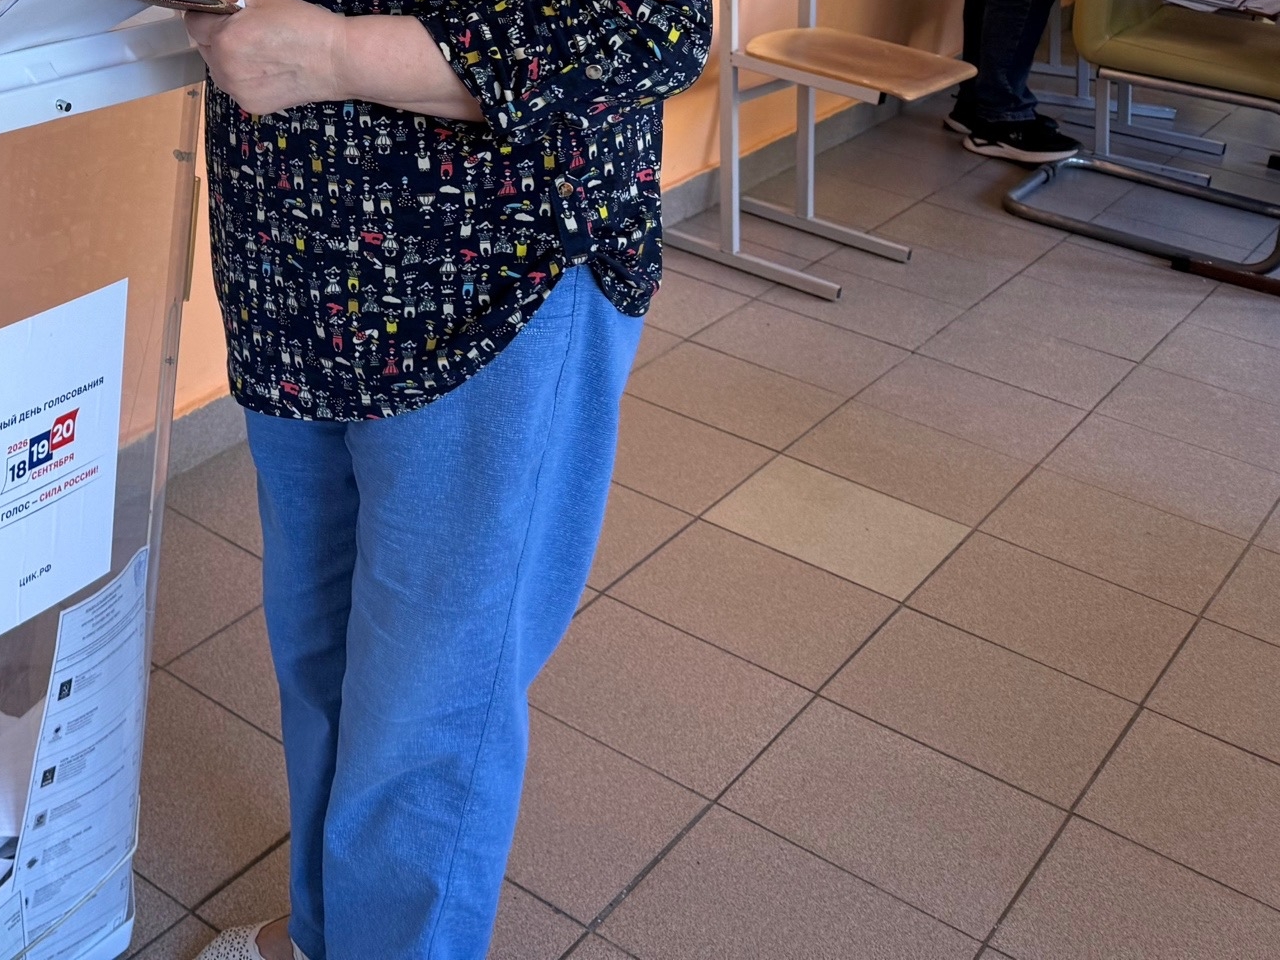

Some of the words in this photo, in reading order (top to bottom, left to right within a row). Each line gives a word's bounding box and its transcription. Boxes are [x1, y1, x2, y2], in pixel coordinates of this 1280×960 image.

[18, 406, 42, 423] ДЕНЬ
[43, 376, 104, 411] ГОЛОСОВАНИЯ
[7, 439, 28, 454] 2026
[9, 460, 27, 482] 18
[31, 440, 49, 462] 19
[52, 419, 74, 444] 20
[31, 452, 74, 480] СЕНТЯБРЯ
[0, 501, 30, 521] ГОЛОС
[39, 485, 62, 502] СИЛА
[64, 465, 99, 489] РОССИИ!
[19, 564, 52, 588] ЦИК.РФ
